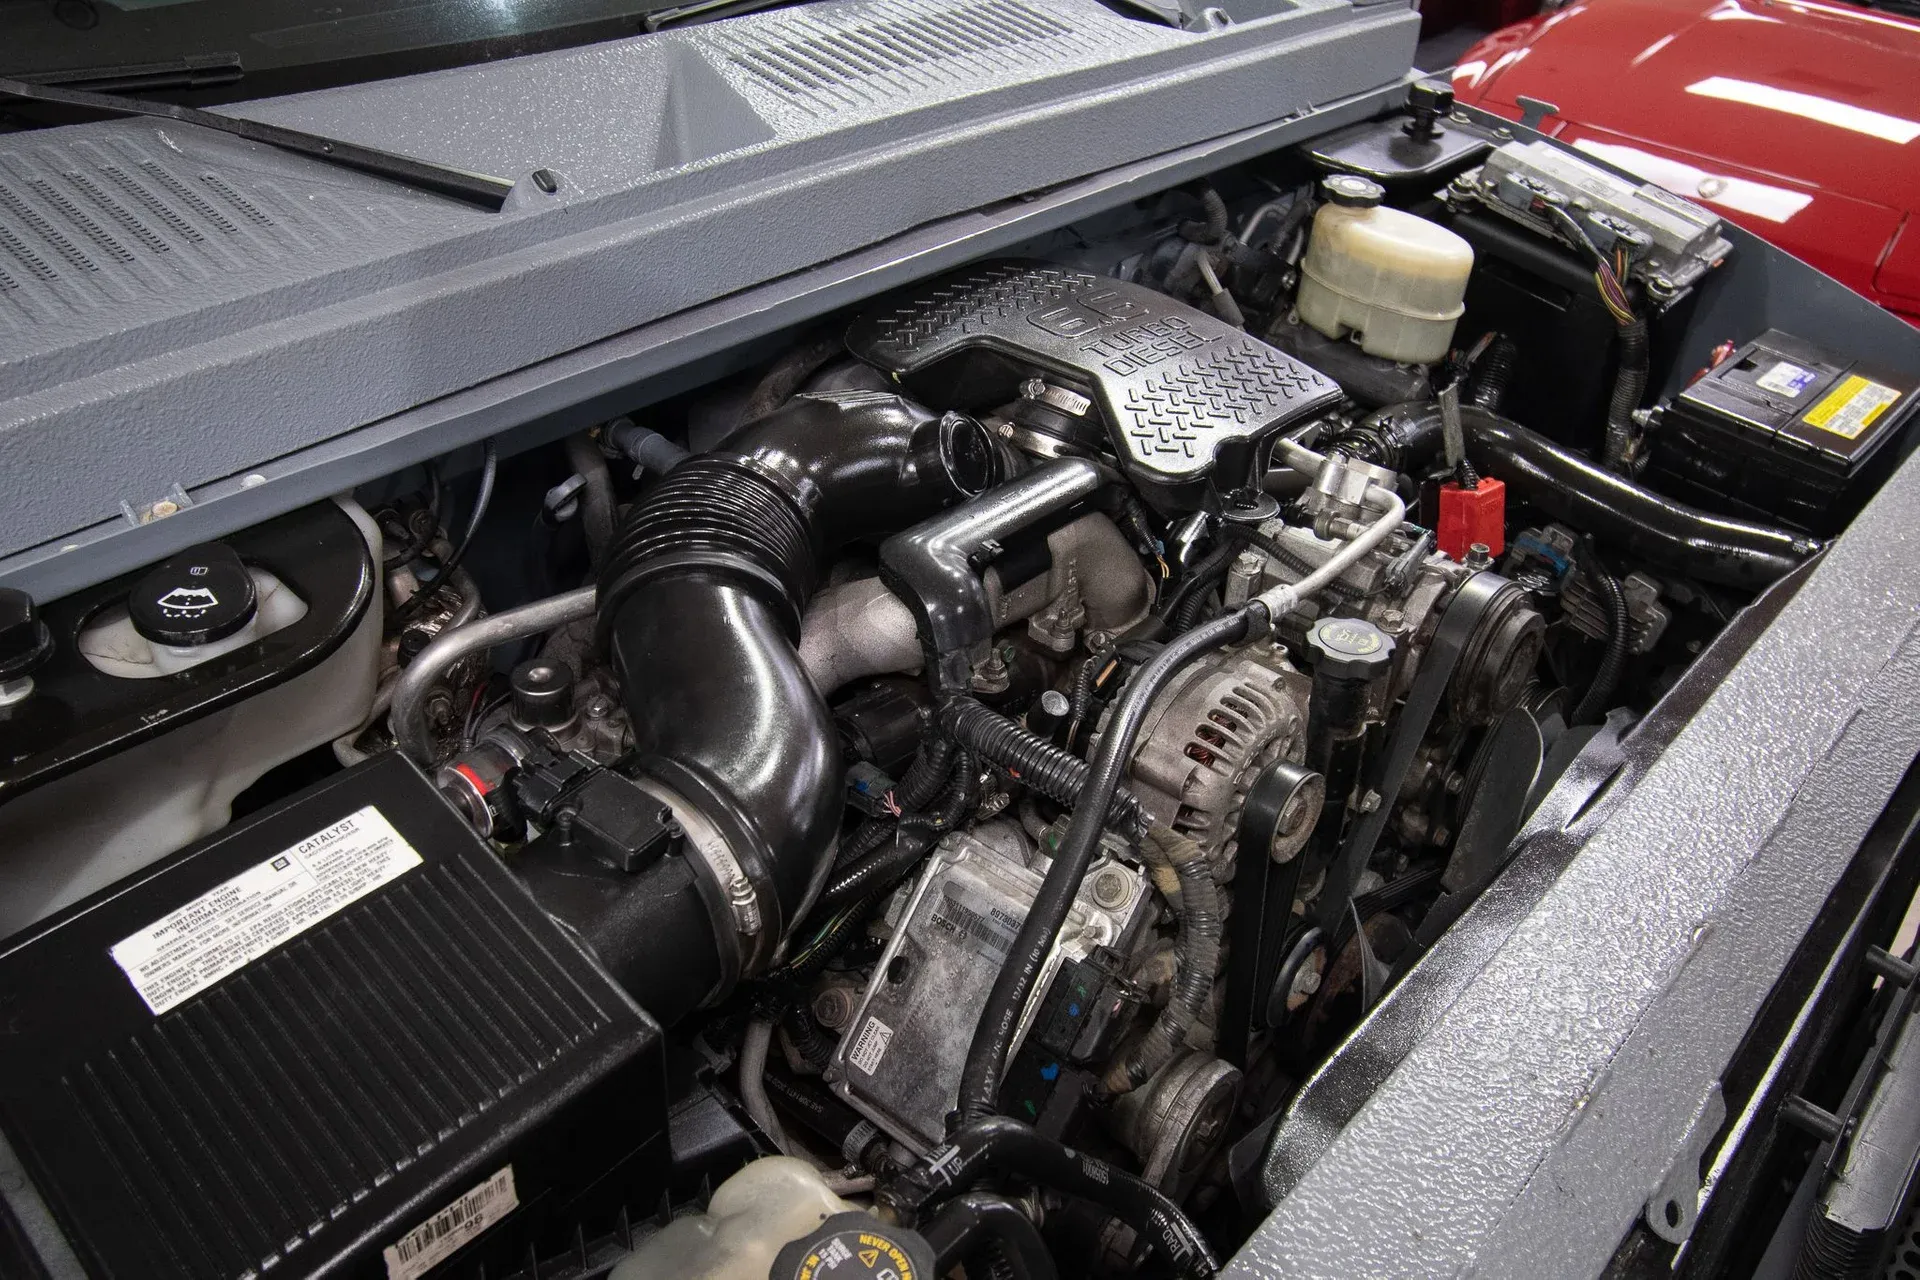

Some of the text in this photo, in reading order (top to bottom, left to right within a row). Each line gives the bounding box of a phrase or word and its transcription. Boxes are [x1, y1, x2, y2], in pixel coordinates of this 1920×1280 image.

[1079, 315, 1192, 358] TURBO
[1102, 331, 1226, 377] DIESEL
[299, 820, 354, 853] CATALYST
[150, 938, 194, 965] ADJUSTMENTS
[238, 901, 261, 916] SERVICE
[263, 887, 286, 901] MANUAL
[152, 886, 241, 938] IMPORTANT ENGINE
[160, 966, 184, 982] ENGINE
[186, 944, 223, 967] CONFORMS
[264, 897, 306, 923] REGULATIONS
[308, 877, 342, 898] APPLICABLE
[354, 862, 367, 871] NEW
[172, 945, 197, 961] MANUAL
[199, 937, 211, 946] FOR
[213, 927, 229, 938] MORE
[232, 903, 271, 927] INFORMATION
[176, 895, 239, 932] INFORMATION
[931, 913, 956, 934] BOSCH
[989, 907, 1023, 931] 8973037
[146, 985, 164, 997] DUTY
[203, 955, 216, 965] THIS
[219, 941, 241, 956] ENGINE
[252, 917, 284, 936] CERTIFIED
[295, 895, 322, 912] OPERATE
[334, 876, 354, 889] DIESEL
[150, 986, 174, 1002] ENGINE
[177, 977, 190, 986] HAS
[199, 955, 229, 974] PRIMARY
[231, 936, 263, 956] INTENDED
[265, 920, 289, 936] SERVICE
[292, 896, 331, 920] APPLICATION
[348, 877, 365, 888] LIGHT
[999, 1008, 1014, 1038] HOSE
[1012, 976, 1028, 1001] 13/32
[1024, 962, 1034, 976] IN
[1037, 926, 1051, 949] MM)
[851, 1021, 875, 1060] WARNING
[947, 1156, 963, 1176] UP
[859, 1233, 910, 1272] NEVER OPEN
[1162, 1229, 1181, 1254] RAD
